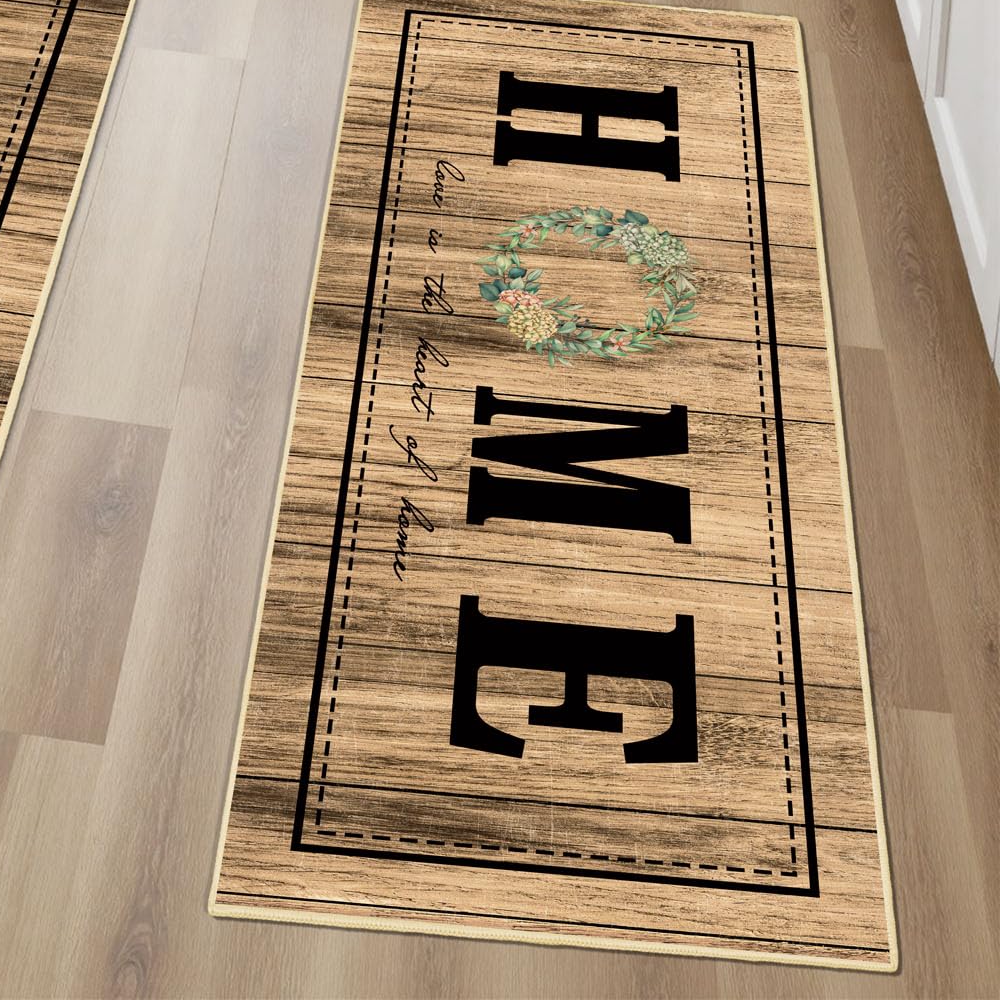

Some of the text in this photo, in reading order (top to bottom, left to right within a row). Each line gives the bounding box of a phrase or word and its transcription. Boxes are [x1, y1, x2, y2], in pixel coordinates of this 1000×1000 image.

[389, 159, 465, 583] love is the heart of home
